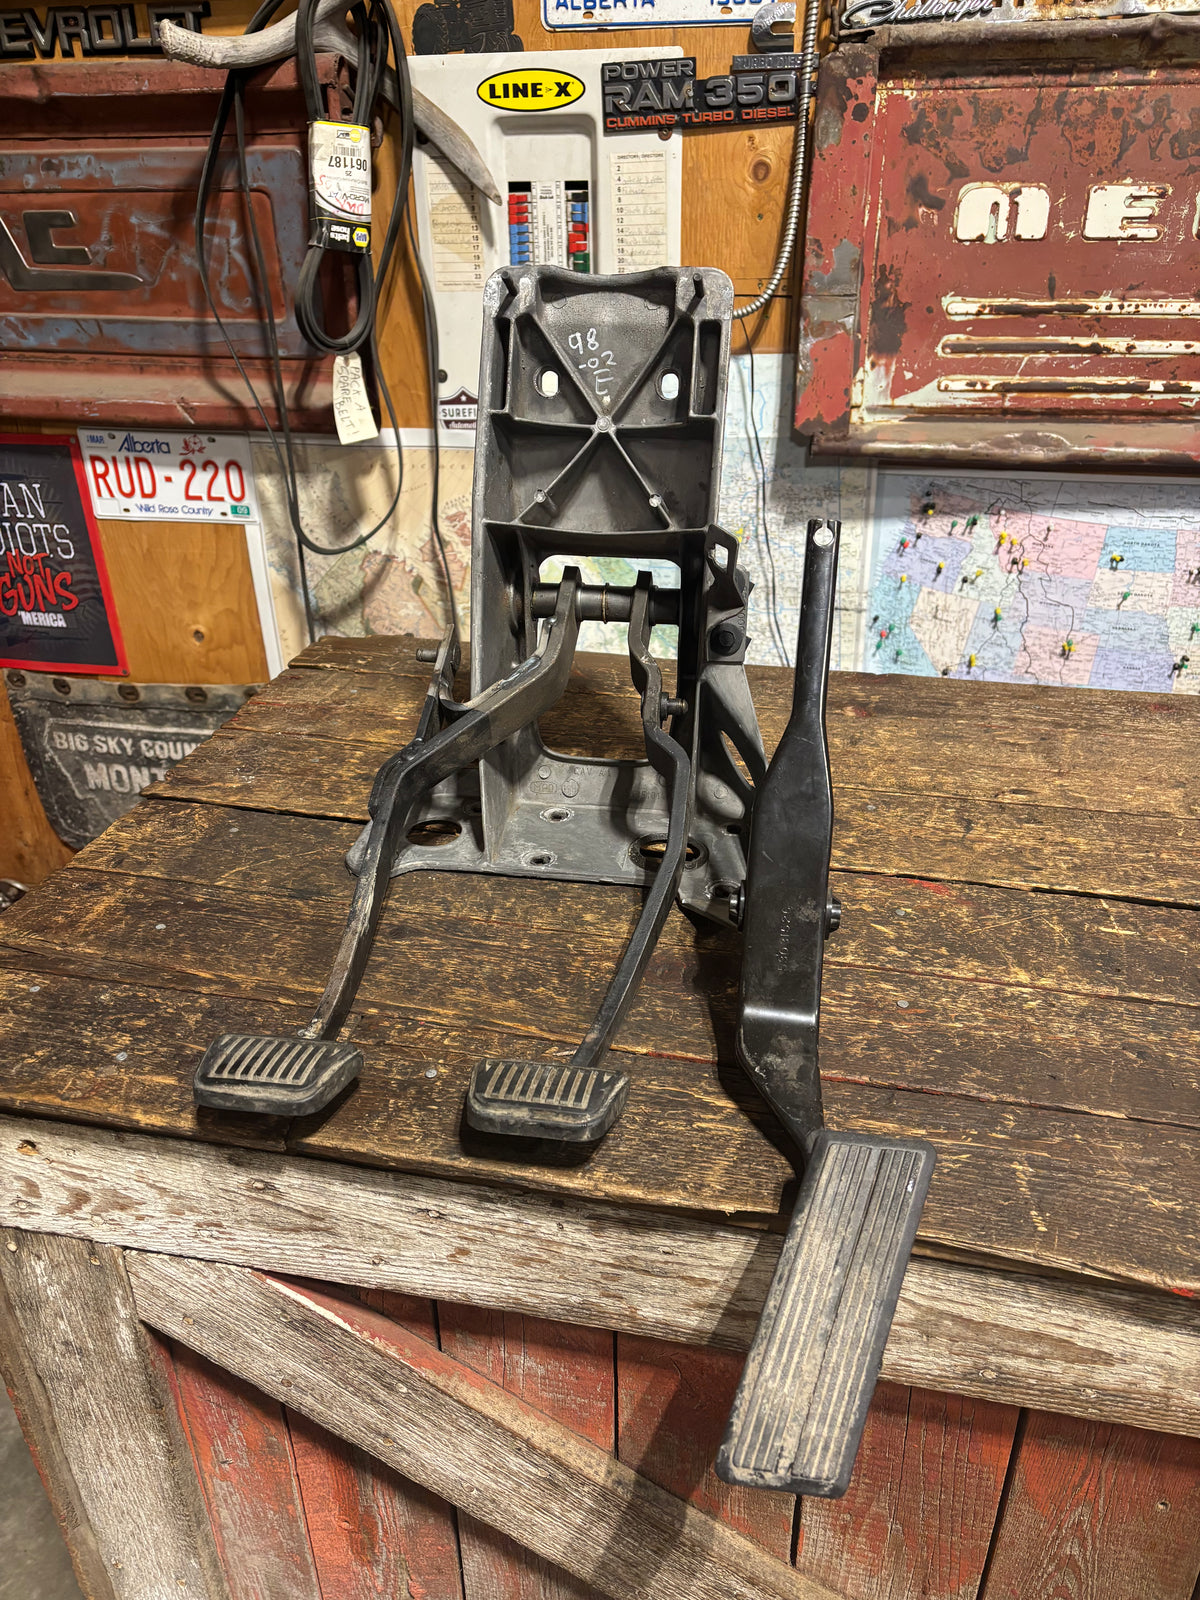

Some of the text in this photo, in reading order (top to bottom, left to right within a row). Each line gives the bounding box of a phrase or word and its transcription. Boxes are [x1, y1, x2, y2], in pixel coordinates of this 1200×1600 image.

[603, 60, 694, 82] POWER
[603, 71, 798, 114] RAM 350
[606, 106, 796, 128] CUMMINS TURBO DIESEL
[327, 155, 368, 171] 061187
[952, 179, 1200, 245] ME
[568, 327, 600, 355] 98
[578, 350, 617, 369] -02
[336, 366, 352, 403] SPARE
[350, 366, 366, 411] PACK A
[89, 432, 171, 454] MAR Alberta
[135, 503, 156, 513] Wild
[158, 504, 179, 514] Rose
[181, 505, 214, 516] Country
[0, 522, 75, 559] IOTS
[6, 549, 49, 578] NOT
[0, 568, 79, 616] GUNS
[17, 610, 67, 628] 'MERICA
[53, 731, 203, 761] BIG SKY COUN
